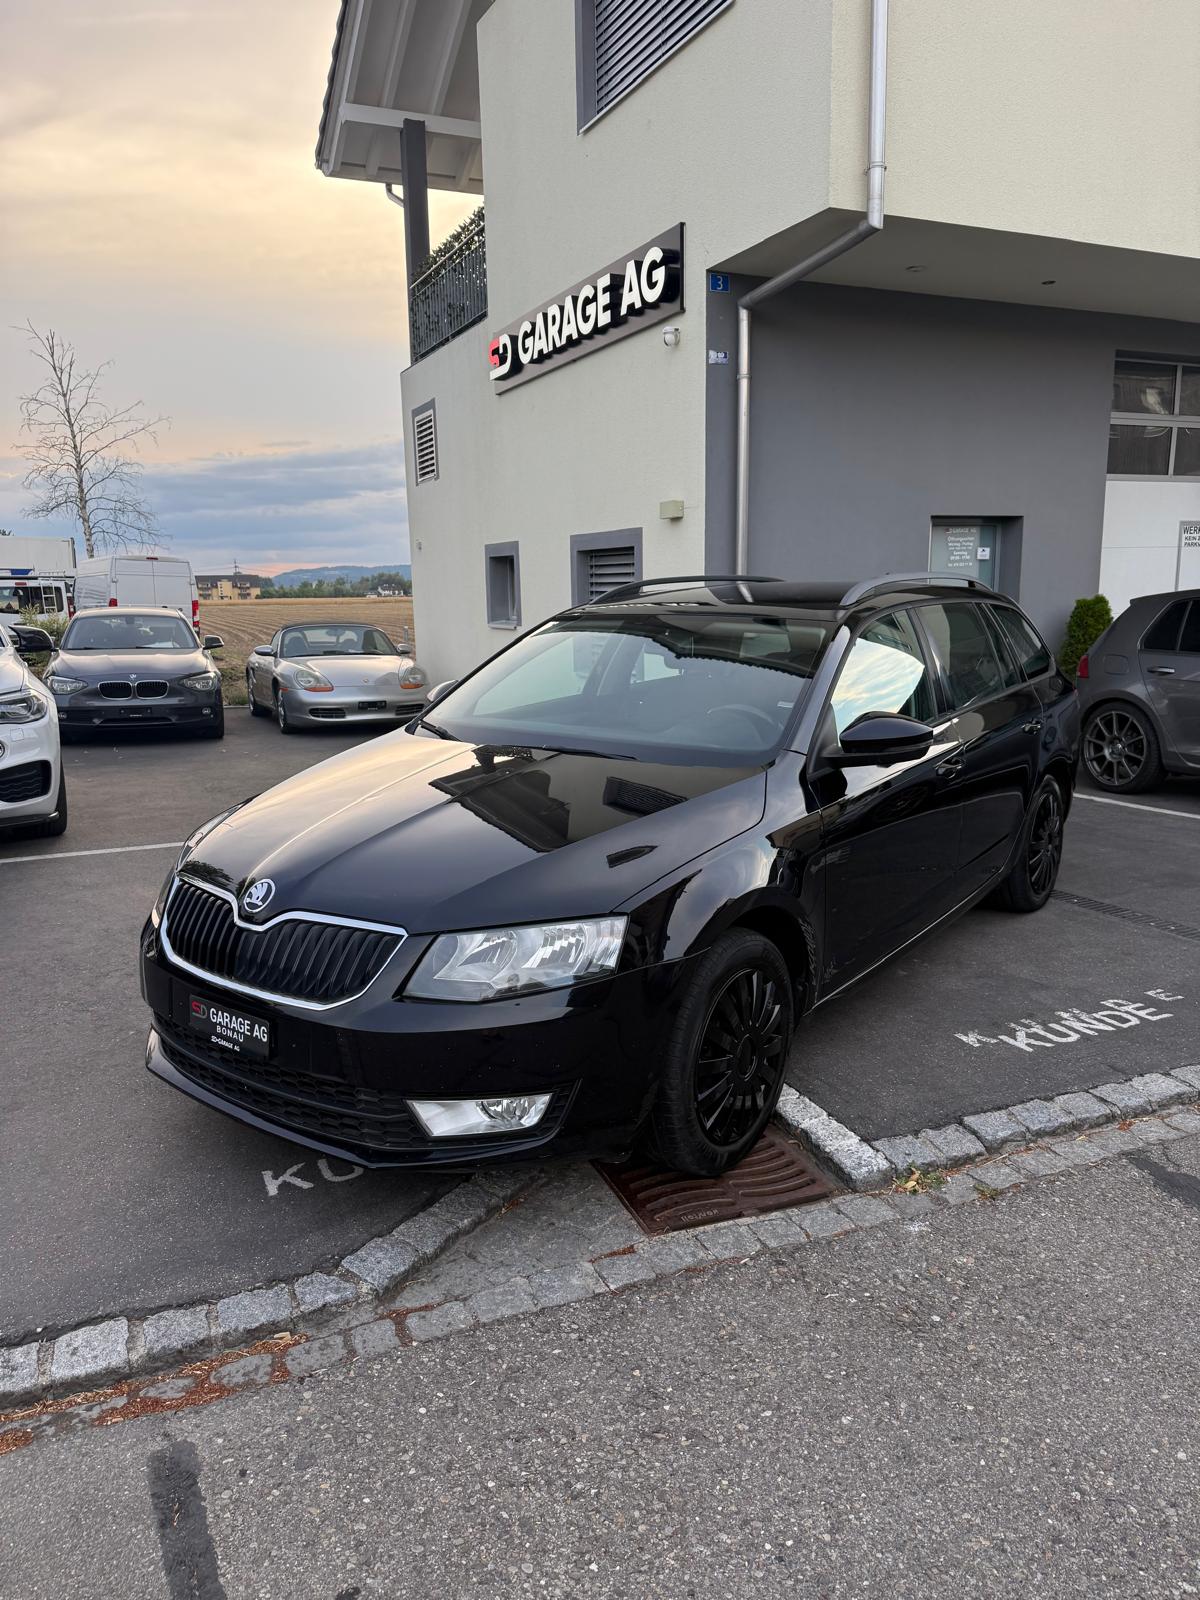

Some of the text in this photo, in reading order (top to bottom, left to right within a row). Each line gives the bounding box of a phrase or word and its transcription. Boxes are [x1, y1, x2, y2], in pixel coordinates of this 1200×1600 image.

[716, 275, 724, 290] 3
[518, 273, 611, 364] GARAGE
[620, 246, 666, 316] AG
[210, 1008, 251, 1036] GARAGE
[253, 1024, 268, 1042] AG
[216, 1025, 244, 1042] BONAU
